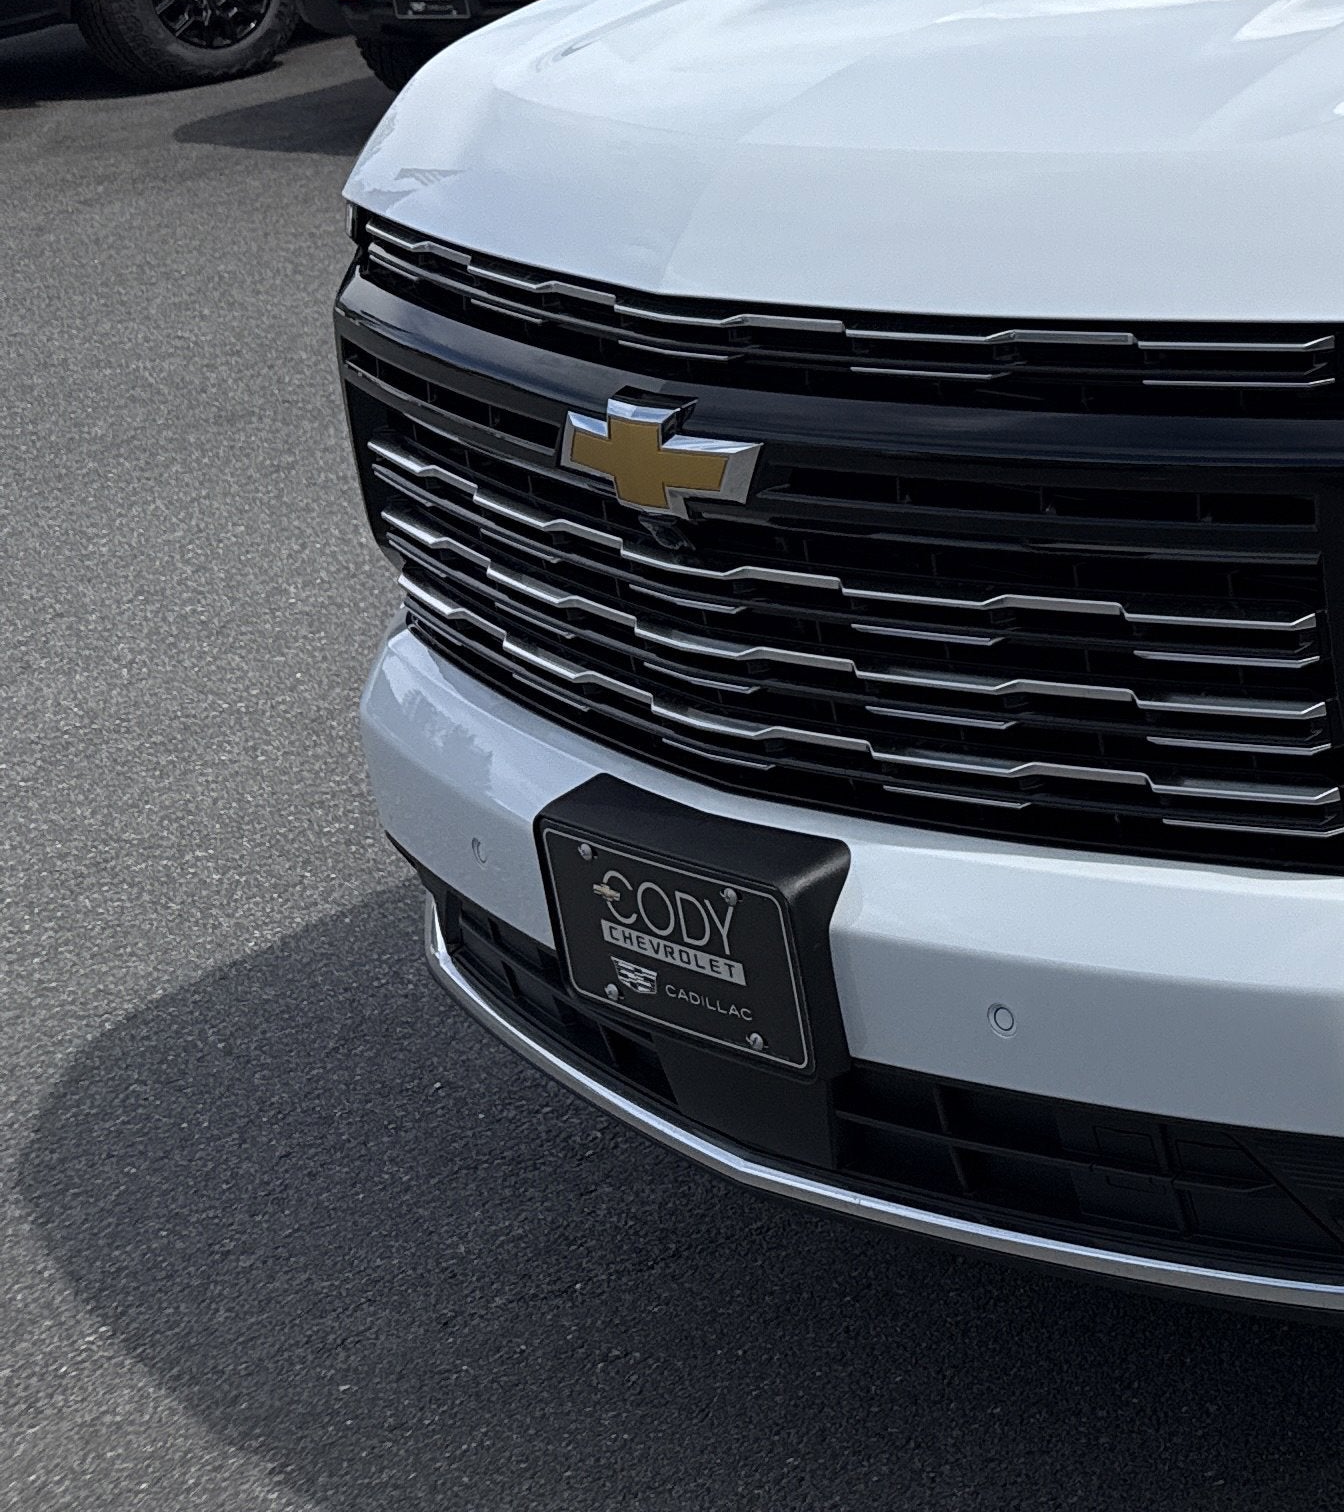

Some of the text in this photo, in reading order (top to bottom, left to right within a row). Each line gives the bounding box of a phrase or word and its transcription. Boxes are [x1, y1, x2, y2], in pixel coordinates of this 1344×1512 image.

[600, 870, 734, 955] CODY
[609, 925, 736, 979] CHEVROLET
[665, 984, 753, 1021] CADILLAC
